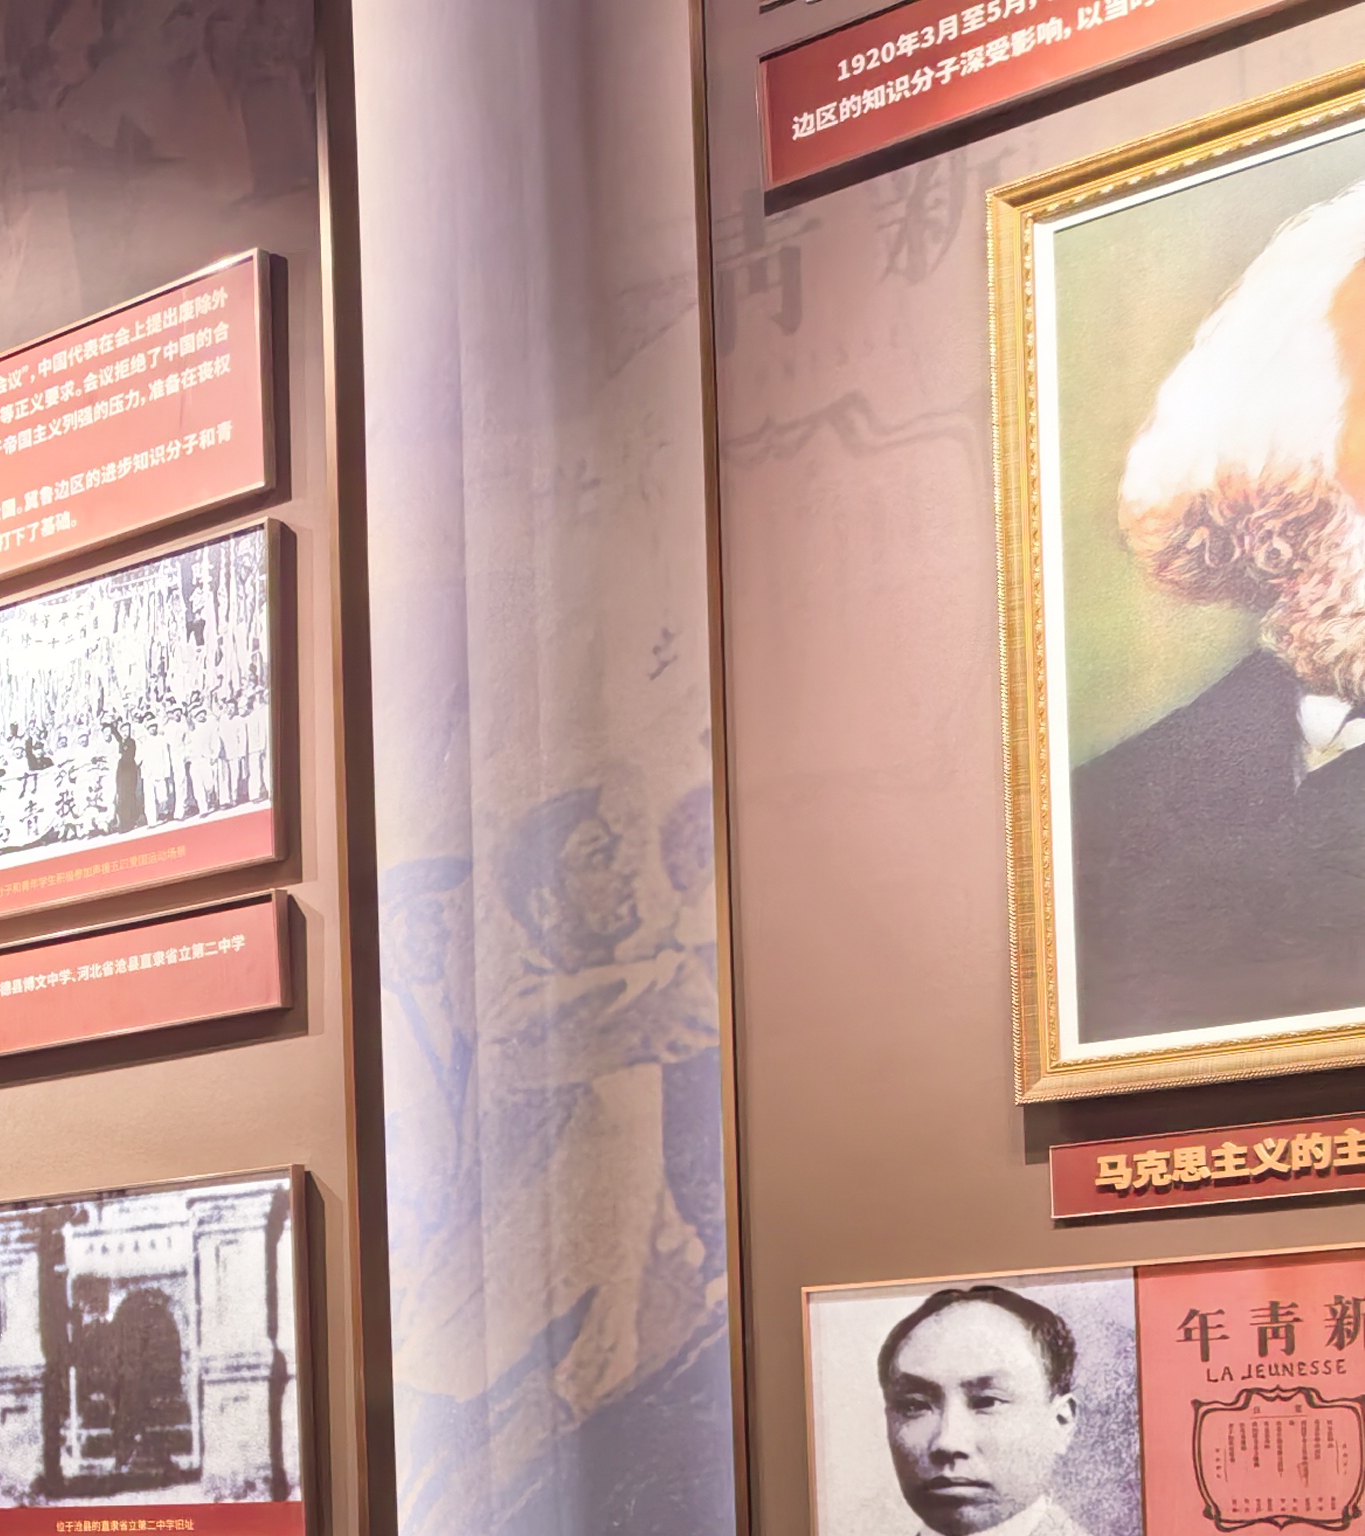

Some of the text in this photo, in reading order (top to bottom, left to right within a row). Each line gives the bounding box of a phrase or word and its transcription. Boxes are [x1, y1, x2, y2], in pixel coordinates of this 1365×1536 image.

[1094, 1127, 1365, 1191] 马克思主义的主
[1206, 1358, 1348, 1383] LA JEUNESSE
